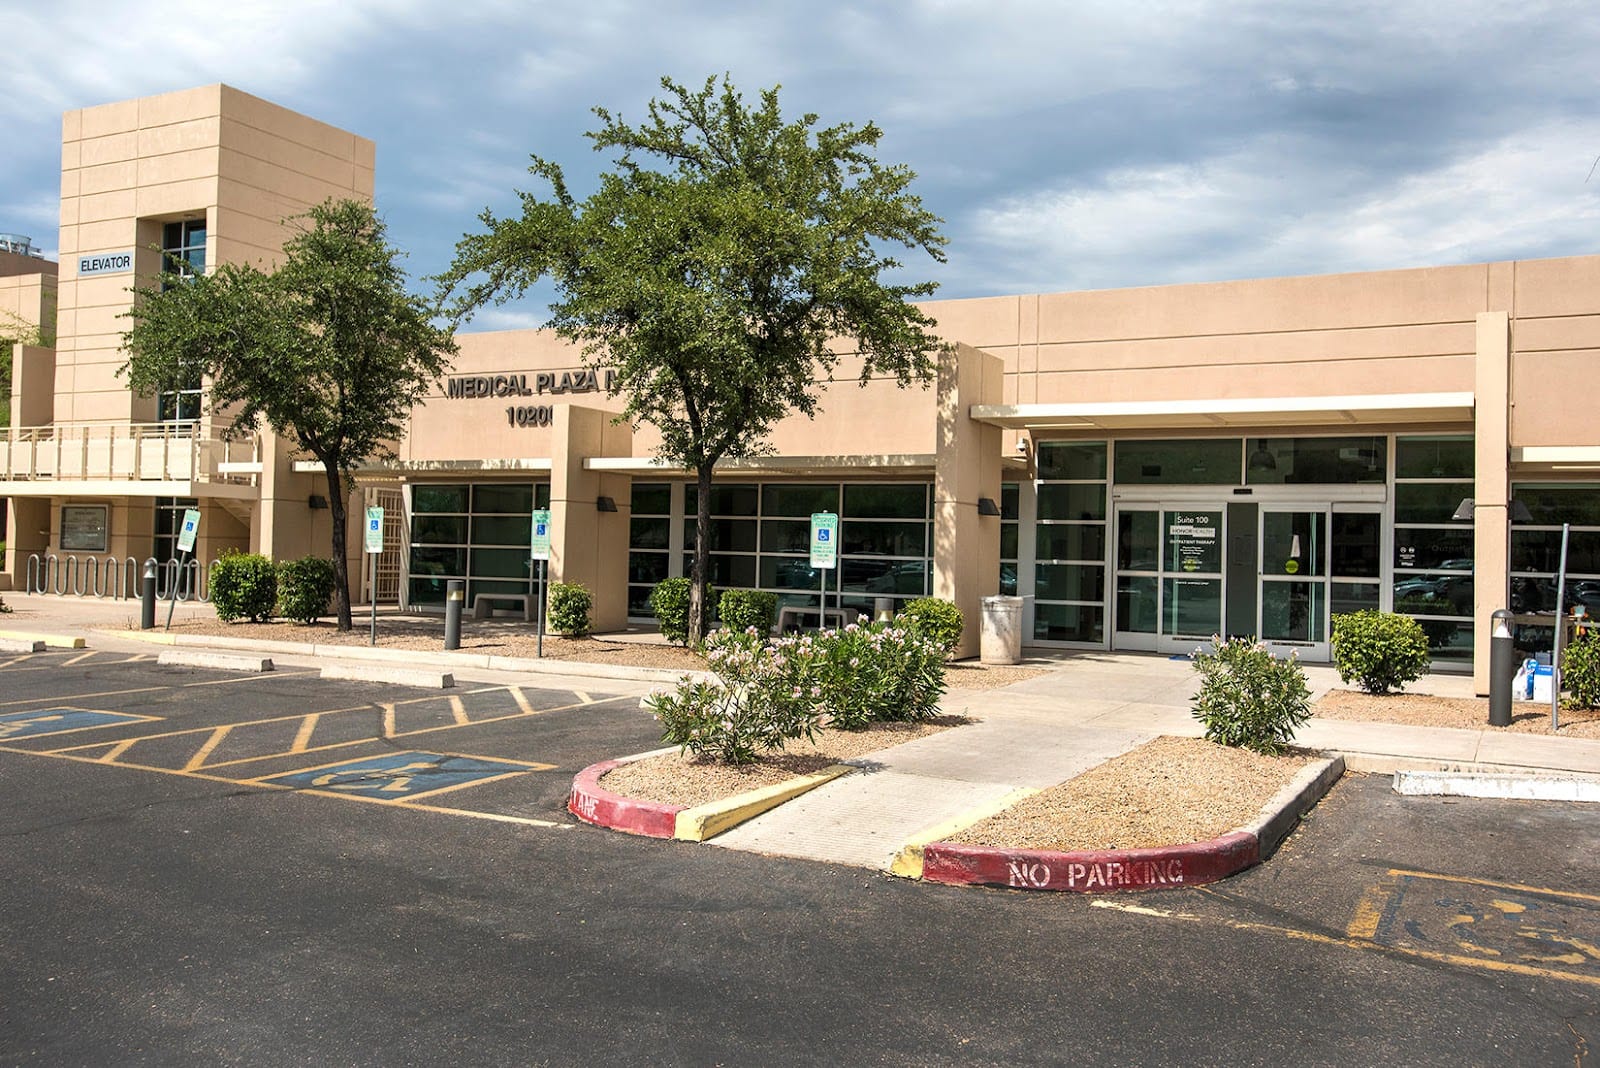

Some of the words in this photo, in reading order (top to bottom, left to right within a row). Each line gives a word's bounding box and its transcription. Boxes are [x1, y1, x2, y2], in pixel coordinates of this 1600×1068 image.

[81, 255, 131, 272] ELEVATOR
[447, 374, 531, 398] MEDICAL
[536, 369, 599, 394] PLAZA
[1177, 515, 1195, 524] Suite
[1195, 516, 1209, 524] 100
[1006, 861, 1051, 887] NO
[1068, 860, 1184, 888] PARKING
